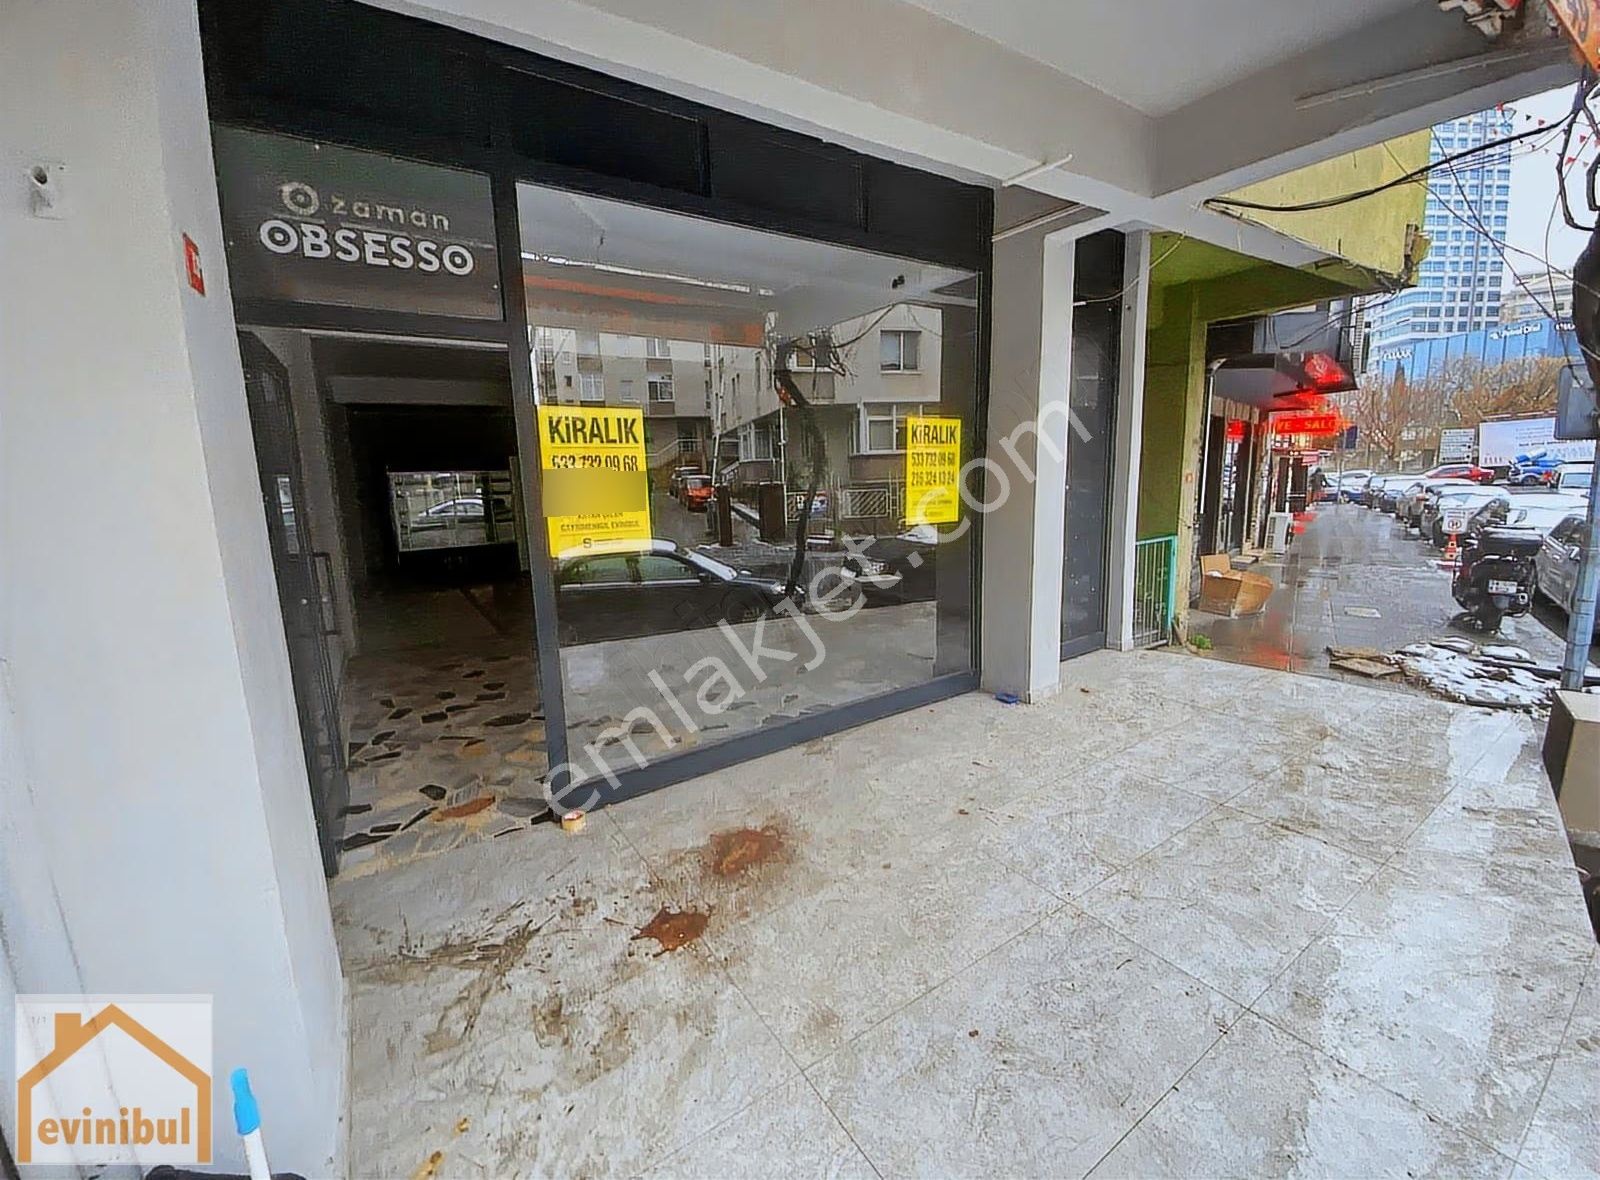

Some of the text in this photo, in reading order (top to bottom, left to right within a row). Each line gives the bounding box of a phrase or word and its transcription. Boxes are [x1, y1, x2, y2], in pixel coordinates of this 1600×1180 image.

[331, 194, 450, 231] zaman
[259, 219, 475, 276] OBSESSO
[605, 455, 620, 472] 09
[623, 455, 639, 472] 68
